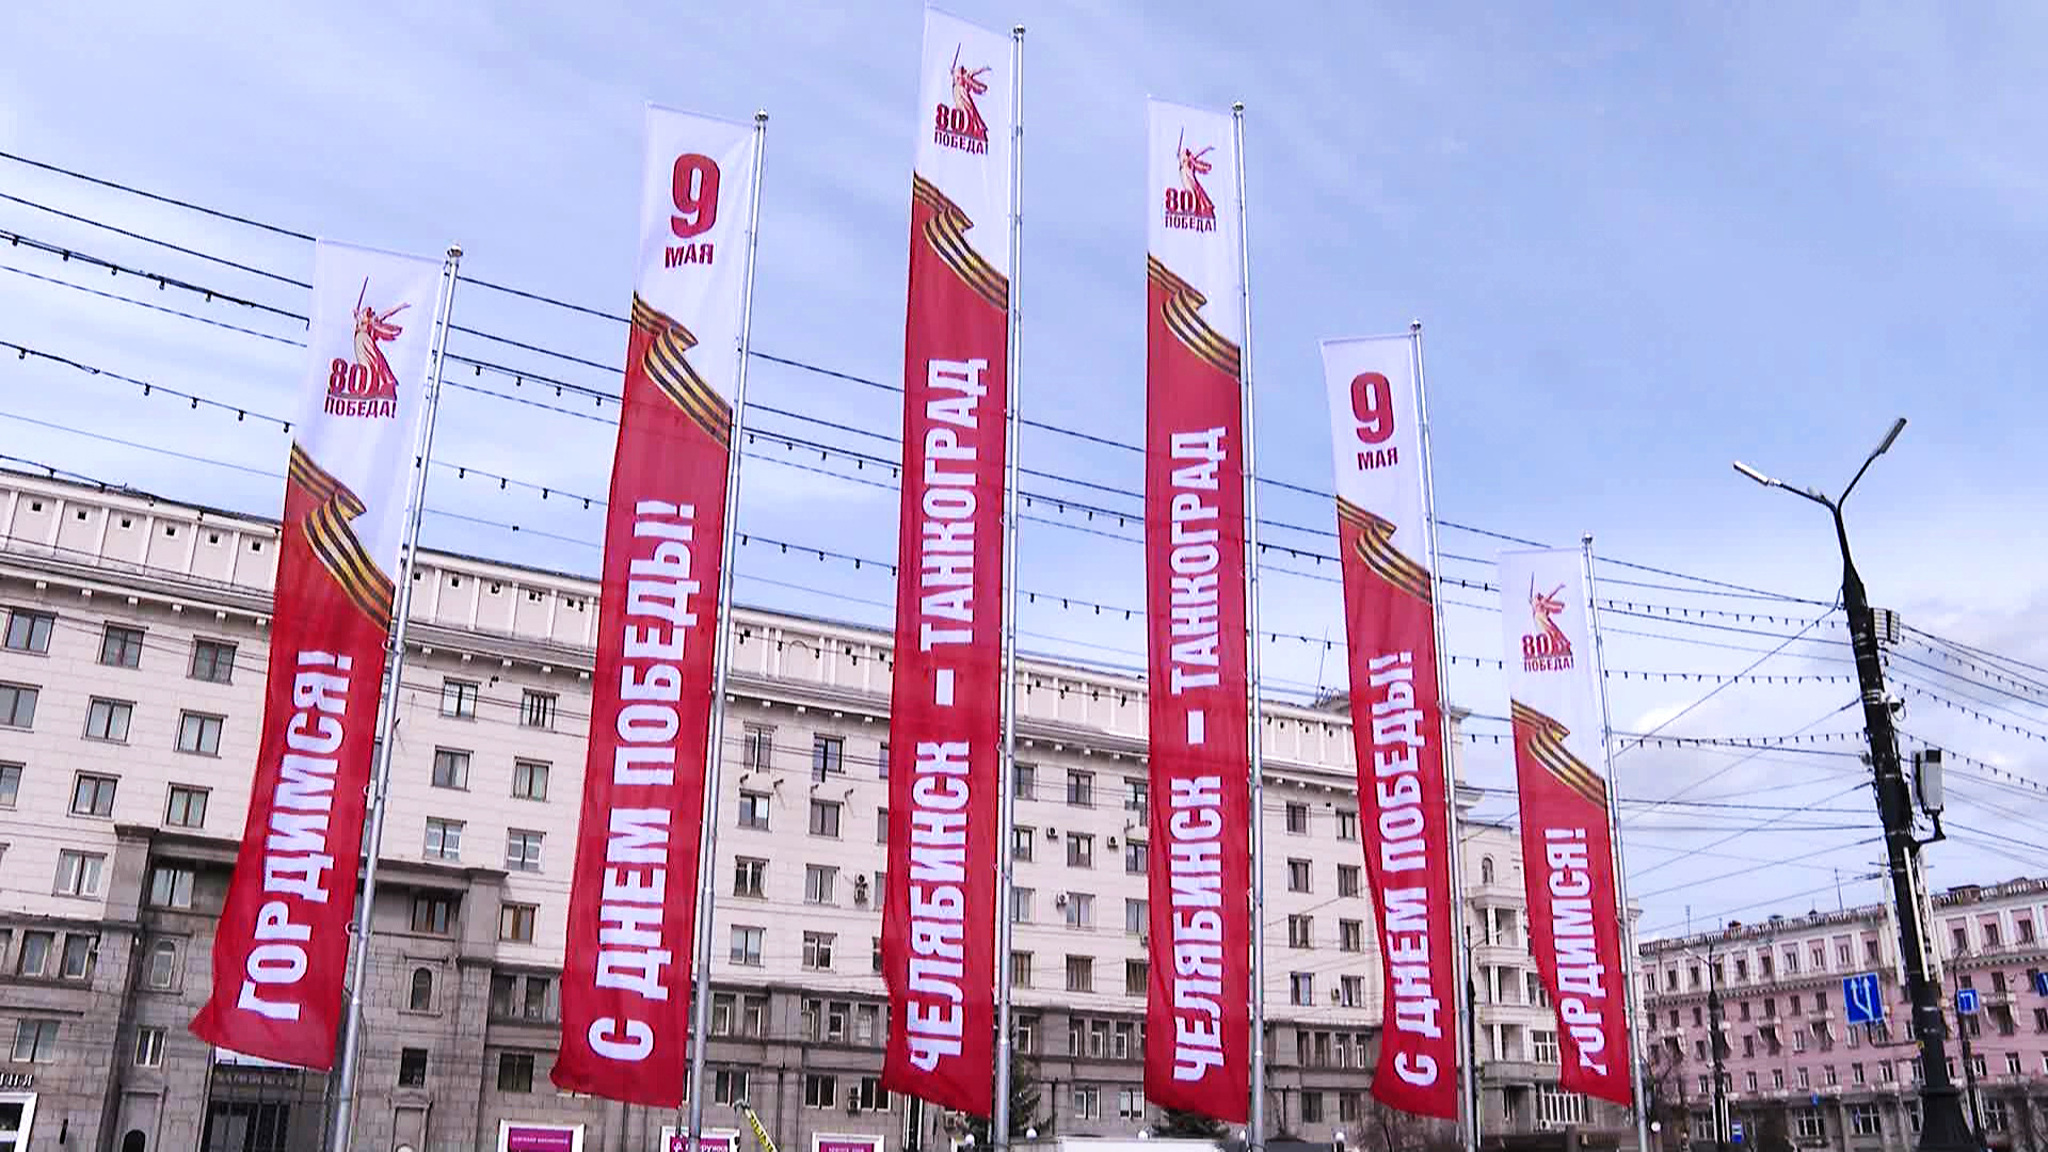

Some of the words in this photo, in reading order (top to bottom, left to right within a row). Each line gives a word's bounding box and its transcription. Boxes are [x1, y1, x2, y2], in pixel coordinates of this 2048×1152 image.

[936, 103, 965, 131] 80
[934, 131, 988, 155] ПОБЕДА!
[671, 154, 720, 238] 9
[1165, 187, 1194, 214] 80
[1165, 215, 1216, 233] ПОБЕДА!
[665, 243, 714, 268] МАЯ
[329, 358, 368, 395] 80
[324, 396, 397, 418] ПОБЕДА!
[1351, 372, 1394, 444] 9
[1357, 447, 1398, 470] МАЯ
[921, 359, 988, 653] ТАНКОГРАД
[1171, 426, 1227, 695] ТАНКОГРАД
[614, 500, 700, 785] ПОБЕДЫ!
[1522, 633, 1549, 658] 80
[1523, 657, 1574, 672] ПОБЕДА!
[1368, 651, 1425, 872] ПОБЕДЫ!
[238, 650, 352, 1021] ГОРДИМСЯ!
[595, 807, 672, 1001] ДНЕМ
[907, 742, 970, 1072] ЧЕЛЯБИНСК
[1170, 776, 1225, 1082] ЧЕЛЯБИНСК
[1384, 887, 1442, 1038] ДНЕМ
[588, 1016, 654, 1061] С
[1394, 1051, 1437, 1086] С
